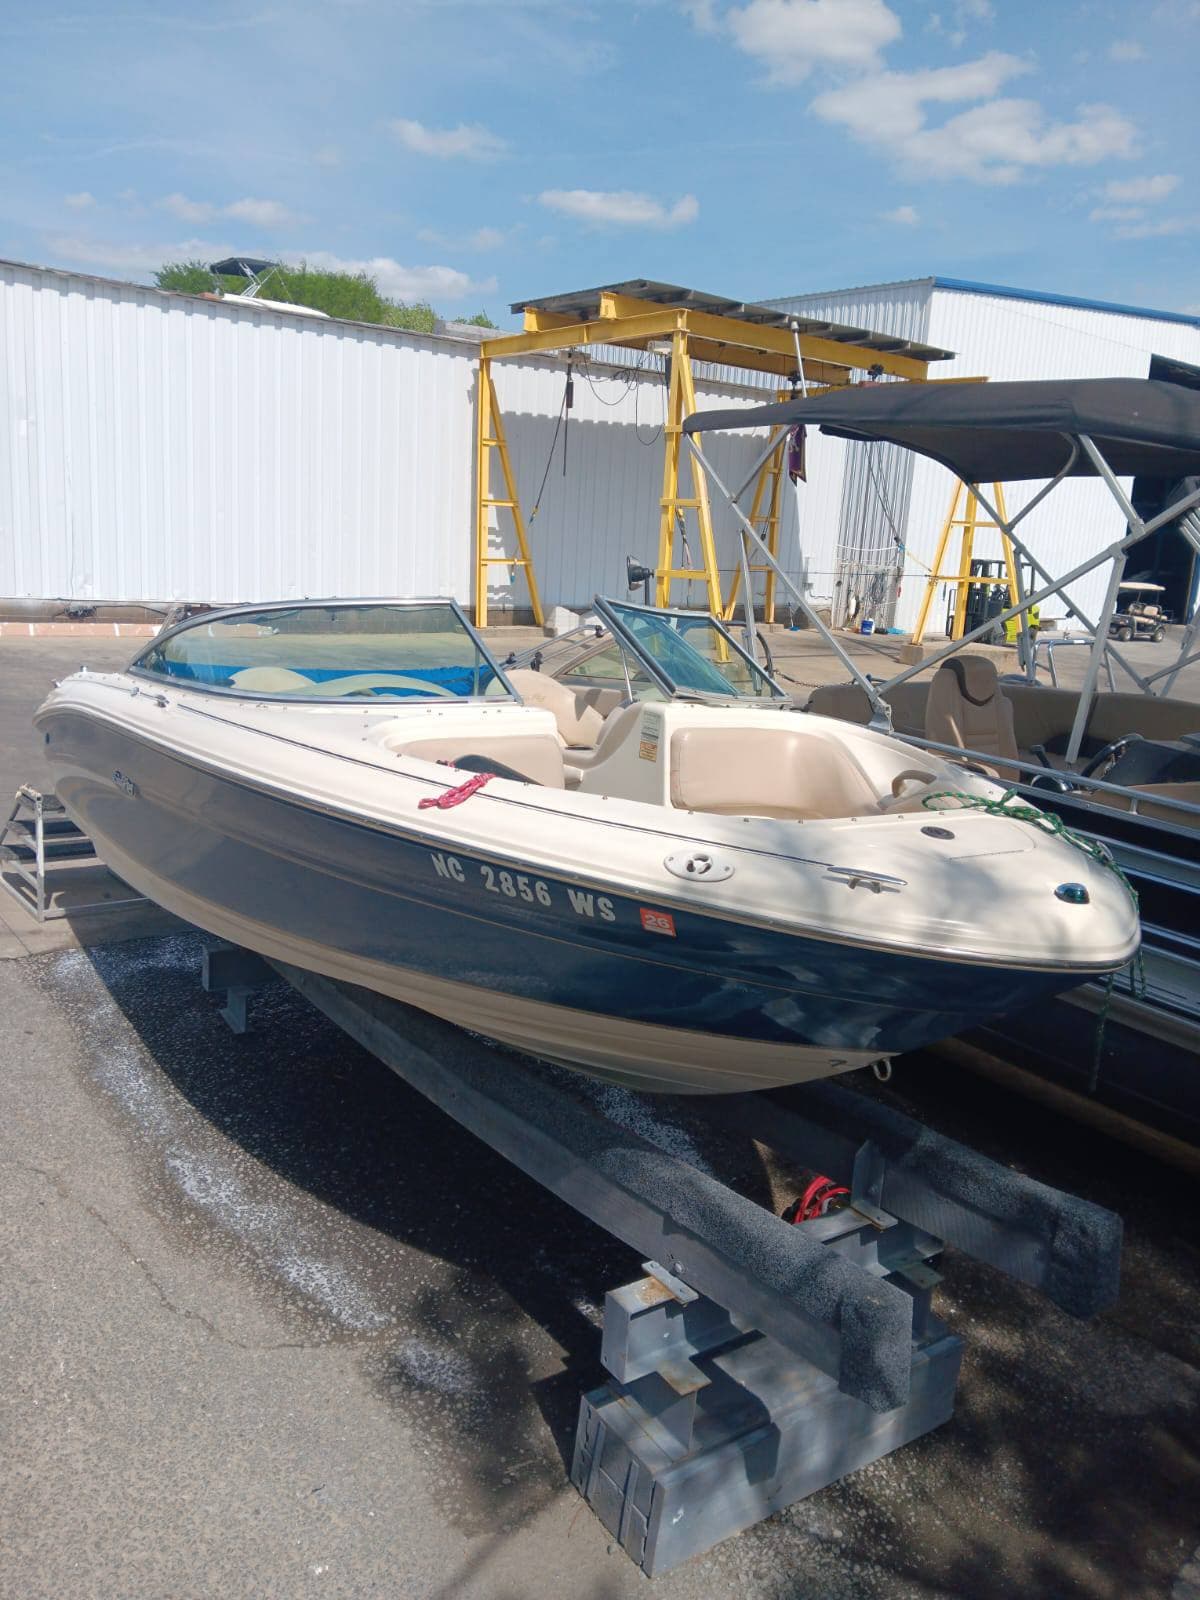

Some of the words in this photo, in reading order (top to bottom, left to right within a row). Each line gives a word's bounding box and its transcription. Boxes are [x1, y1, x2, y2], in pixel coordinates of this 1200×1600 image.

[431, 853, 465, 882] NC
[480, 865, 551, 906] 2856
[567, 888, 616, 921] WS
[644, 914, 670, 929] 26
